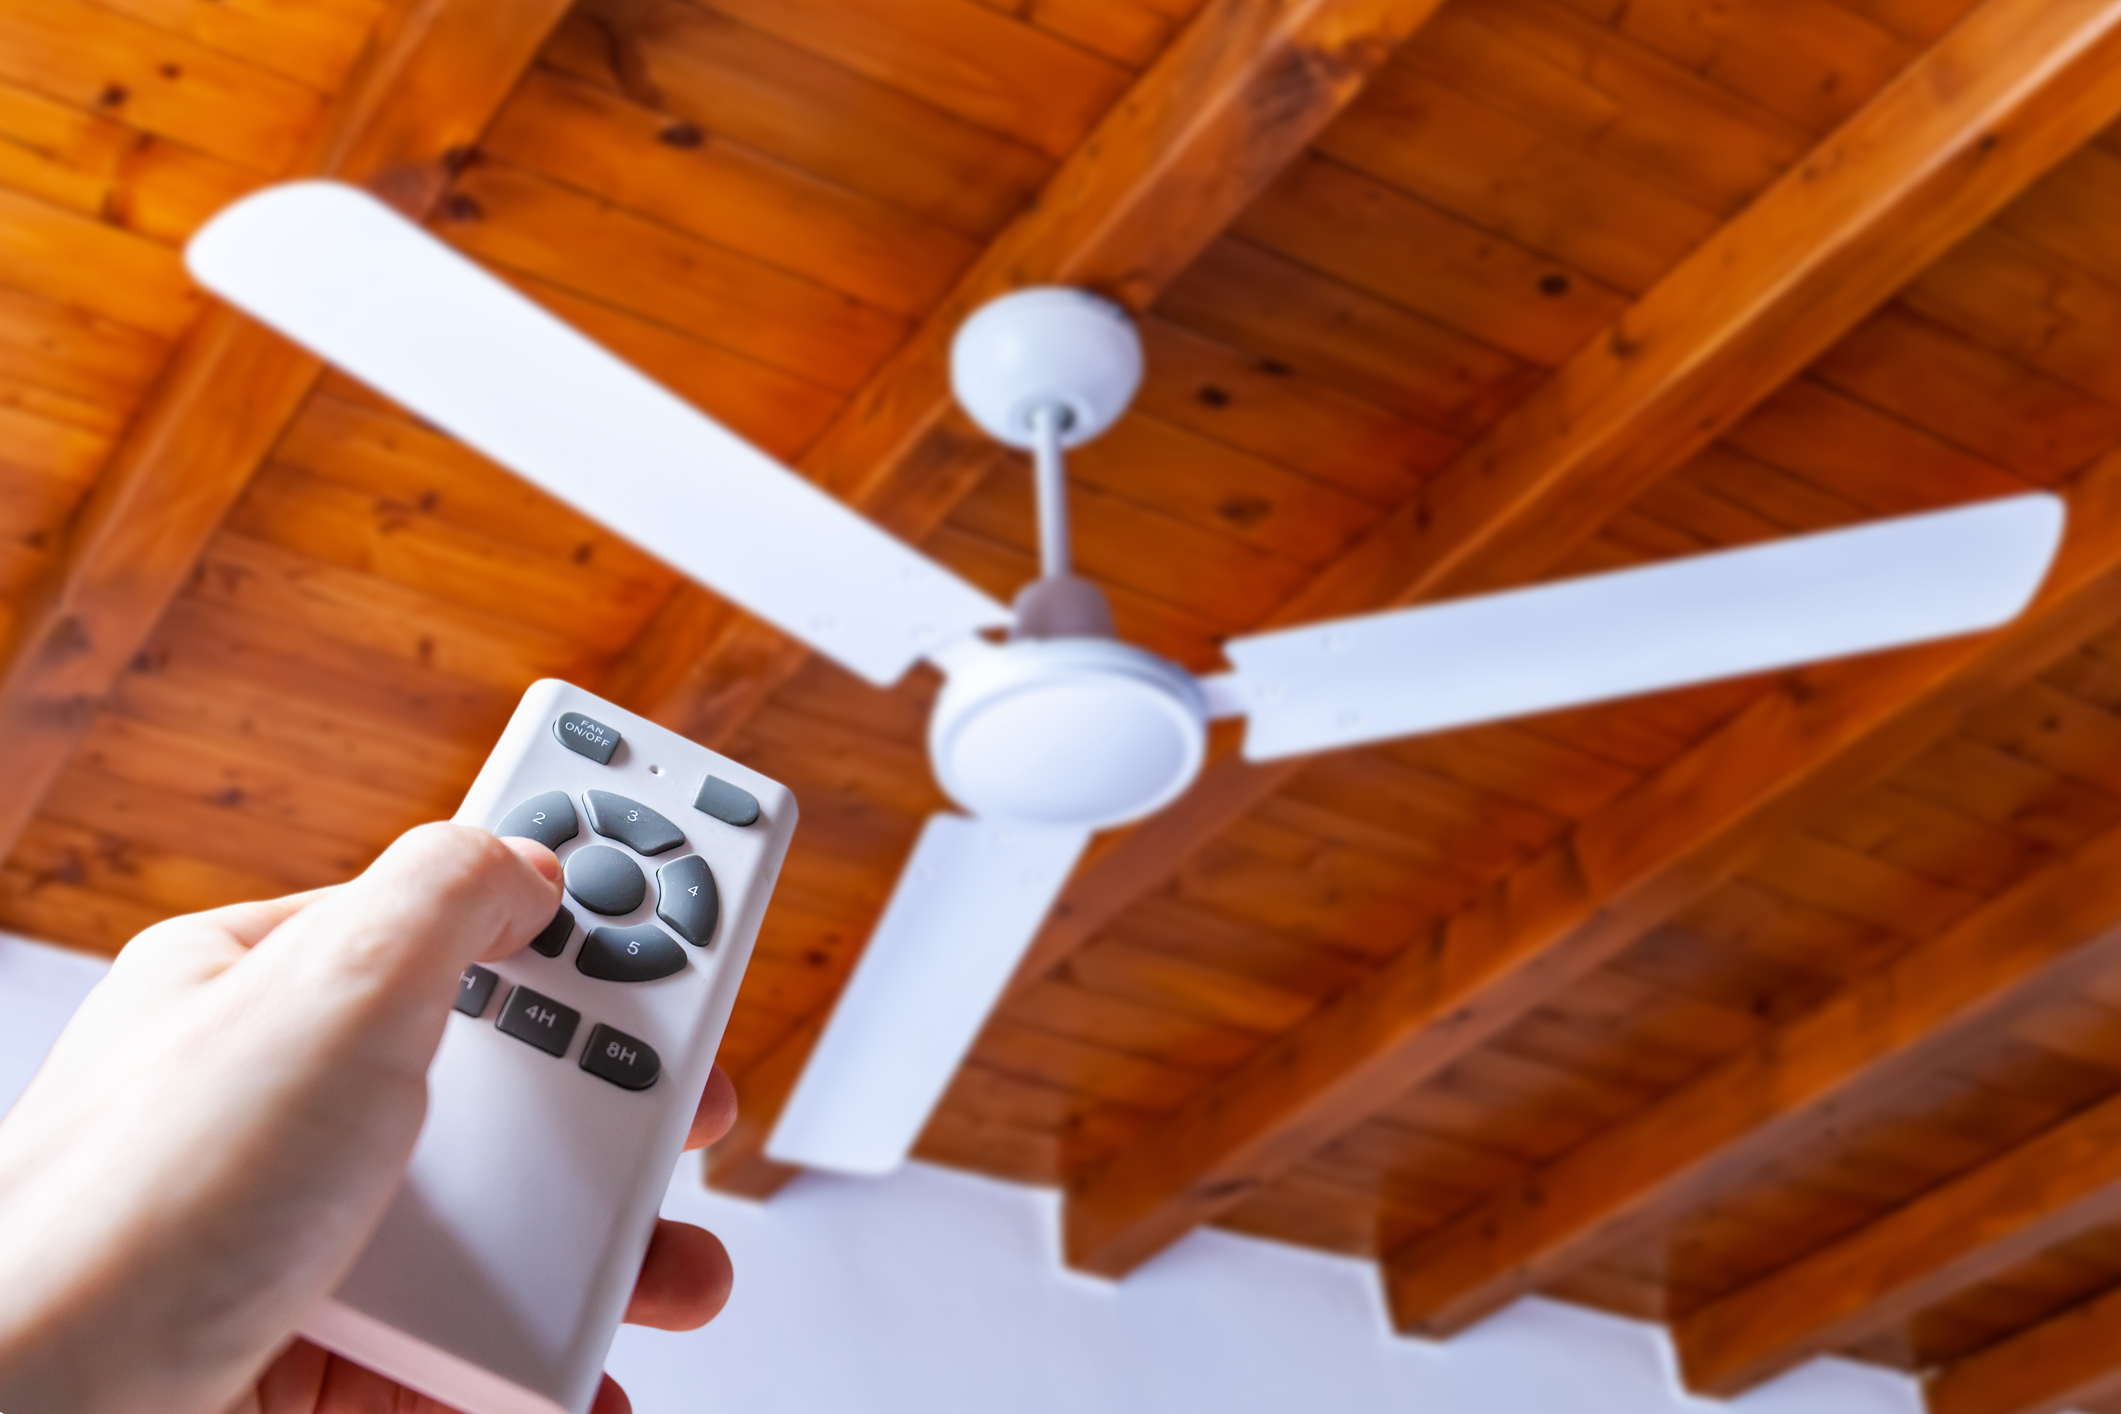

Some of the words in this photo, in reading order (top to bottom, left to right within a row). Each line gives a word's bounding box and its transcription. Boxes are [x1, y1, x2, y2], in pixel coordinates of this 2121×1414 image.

[564, 721, 611, 747] ON/OFF
[581, 719, 605, 736] FAN
[531, 811, 546, 825] 2
[626, 809, 639, 822] 3
[687, 885, 699, 897] 4
[626, 941, 641, 956] 5
[458, 970, 477, 990] H
[524, 1004, 557, 1028] 4H
[605, 1041, 638, 1067] 8H
